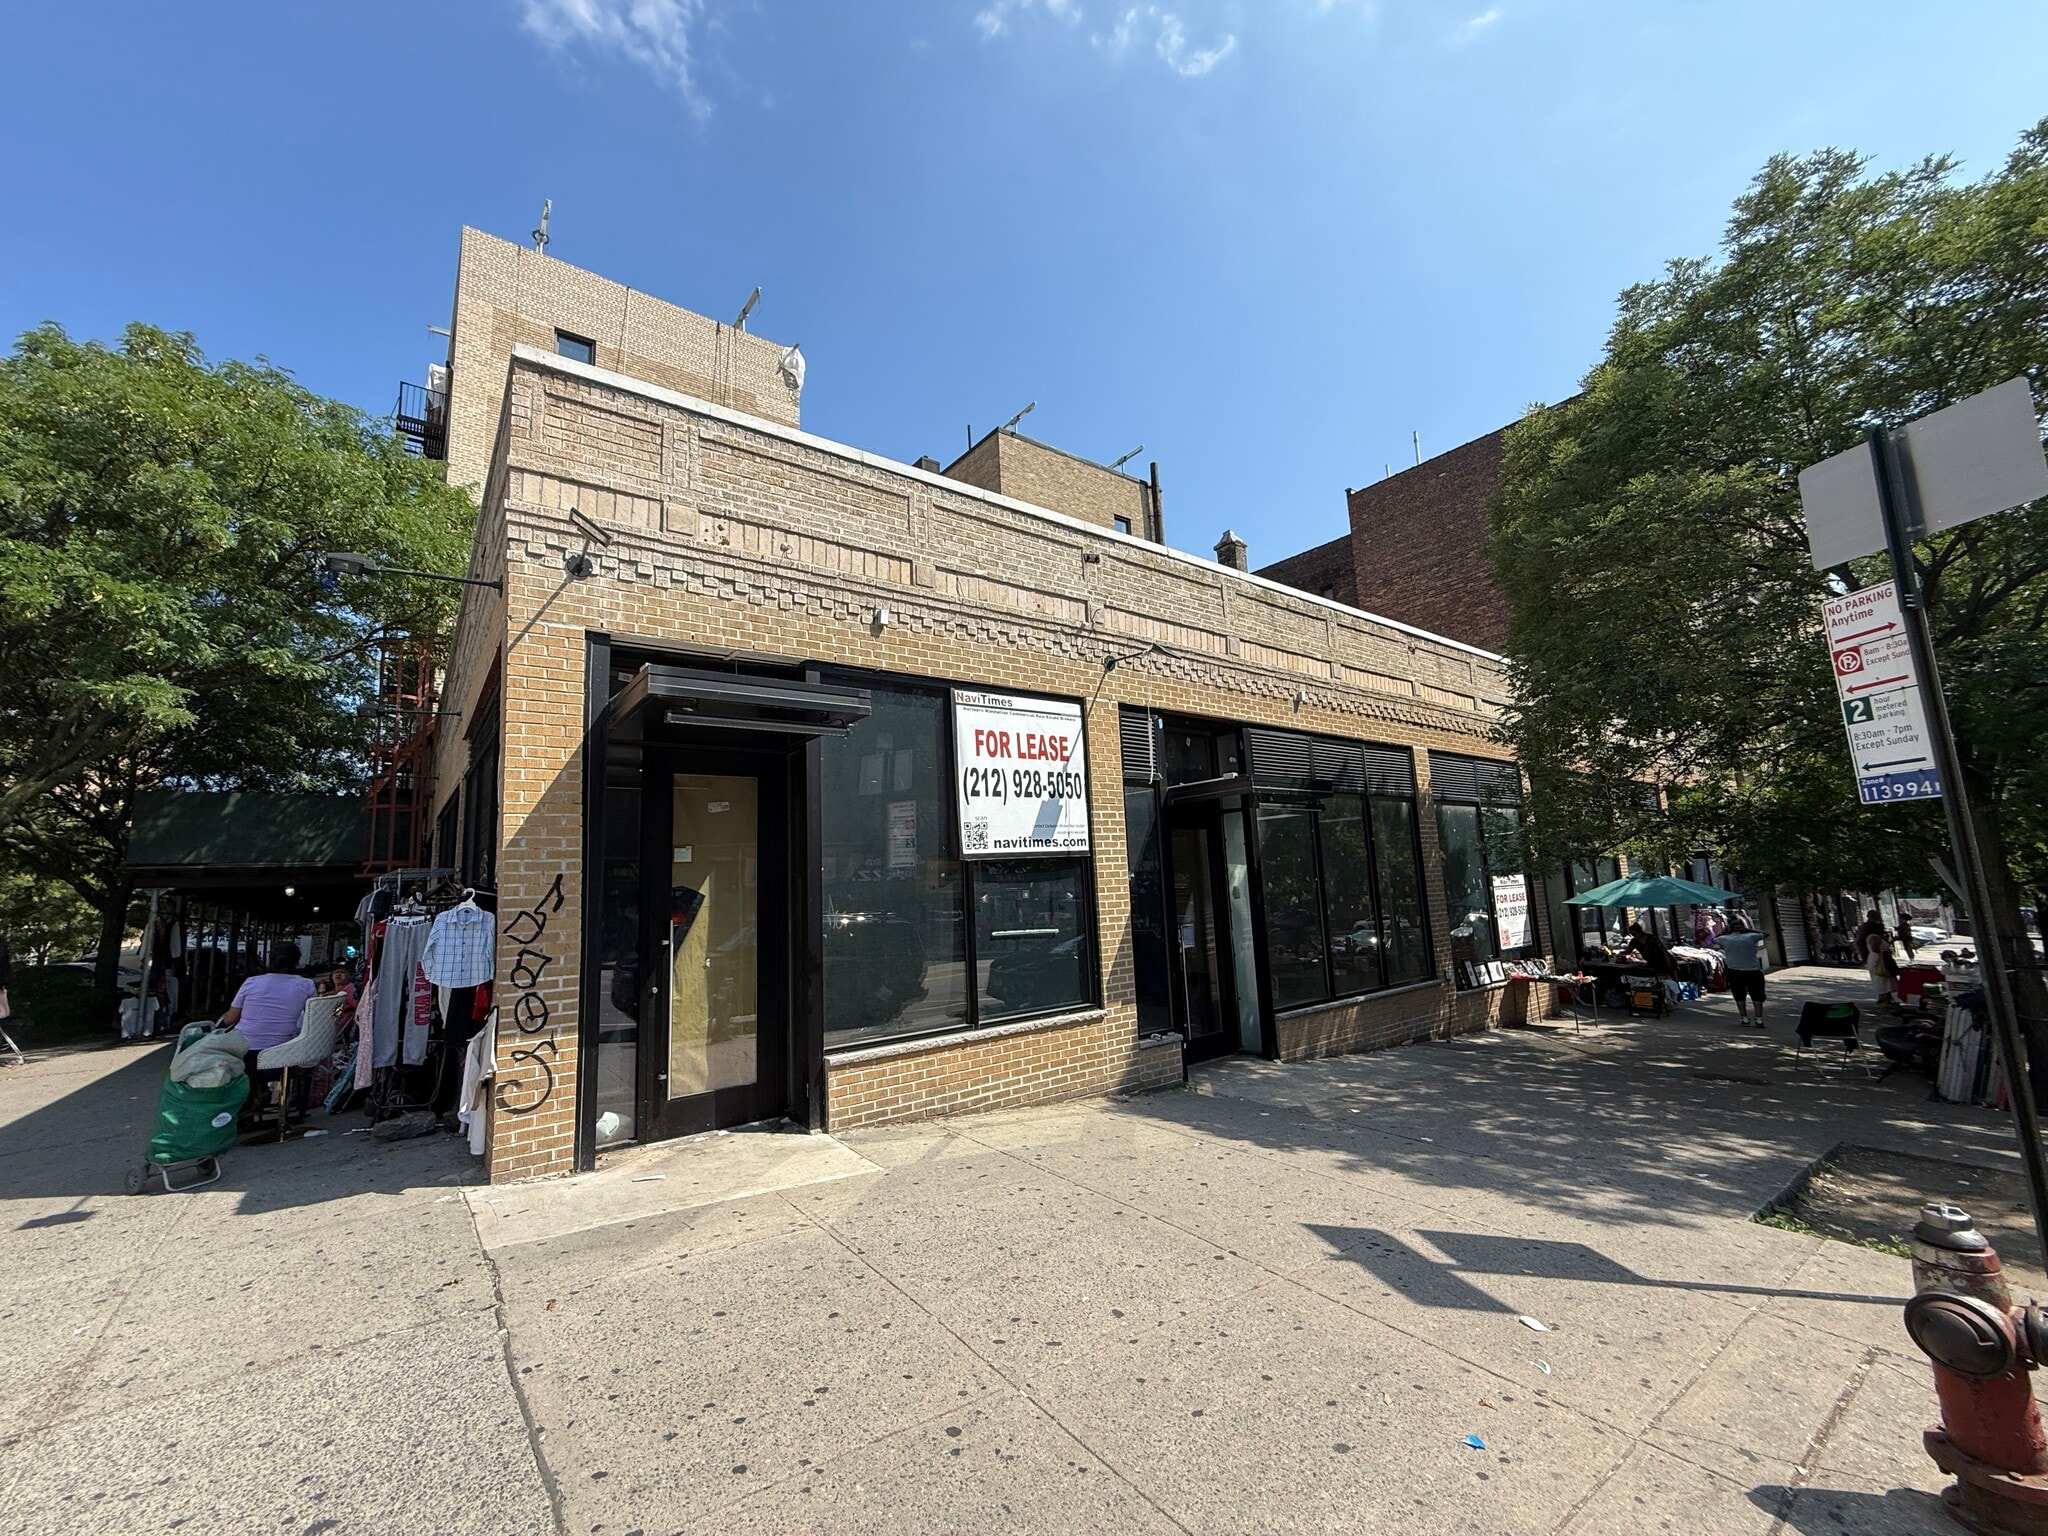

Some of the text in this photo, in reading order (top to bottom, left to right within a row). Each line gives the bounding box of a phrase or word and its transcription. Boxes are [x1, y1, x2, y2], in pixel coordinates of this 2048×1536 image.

[1827, 587, 1893, 616] NO PARKING
[1831, 608, 1874, 628] Anytime
[1864, 647, 1880, 656] 8am
[1886, 639, 1907, 650] 8:30a
[1866, 648, 1910, 666] Except Sund
[956, 692, 1013, 707] NaviTimes
[1873, 695, 1891, 705] hour
[1875, 700, 1908, 712] metered
[1849, 700, 1867, 722] 2
[1877, 709, 1906, 721] parking
[1853, 729, 1885, 741] 8:30am
[1893, 724, 1913, 735] 7pm
[975, 729, 1070, 762] FOR LEASE
[1855, 733, 1919, 751] Except Sunday
[963, 767, 1082, 806] (212) 928-5050
[994, 836, 1087, 849] navitimes.com
[1496, 892, 1525, 904] FOR LEASE
